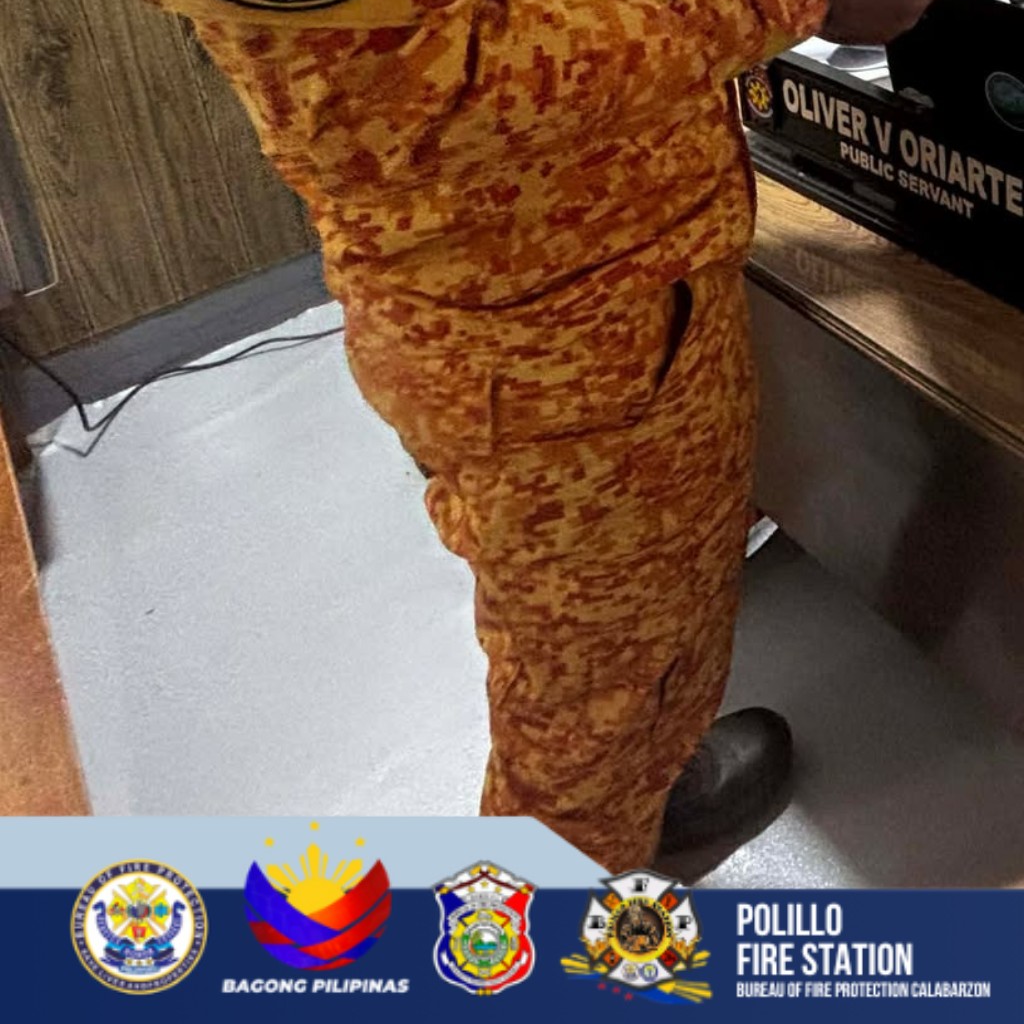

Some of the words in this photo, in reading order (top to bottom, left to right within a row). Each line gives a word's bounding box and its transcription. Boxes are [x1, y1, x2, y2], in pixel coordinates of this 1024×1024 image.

[782, 78, 870, 146] OLIVER
[873, 115, 892, 155] V
[900, 129, 1024, 217] ORIARTE
[840, 141, 894, 181] PUBLIC
[898, 169, 974, 219] SERVANT
